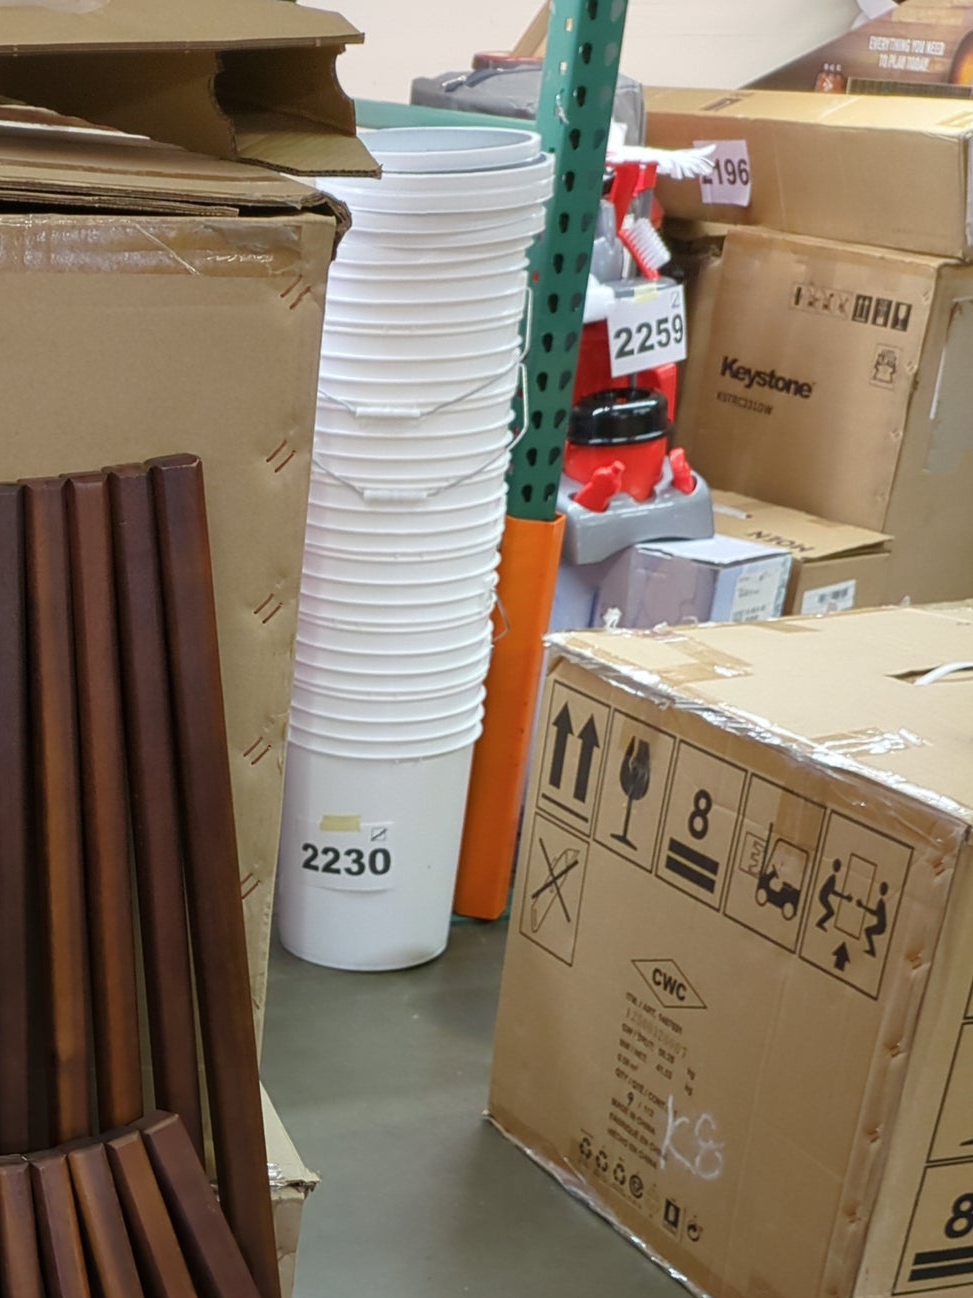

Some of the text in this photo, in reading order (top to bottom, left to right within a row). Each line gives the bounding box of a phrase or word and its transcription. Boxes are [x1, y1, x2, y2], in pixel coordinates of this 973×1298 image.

[613, 314, 683, 359] 2259
[720, 355, 812, 399] Keystone
[687, 789, 713, 840] 8
[301, 842, 391, 876] 2230
[652, 968, 687, 1001] CWC
[944, 1192, 973, 1239] 8
